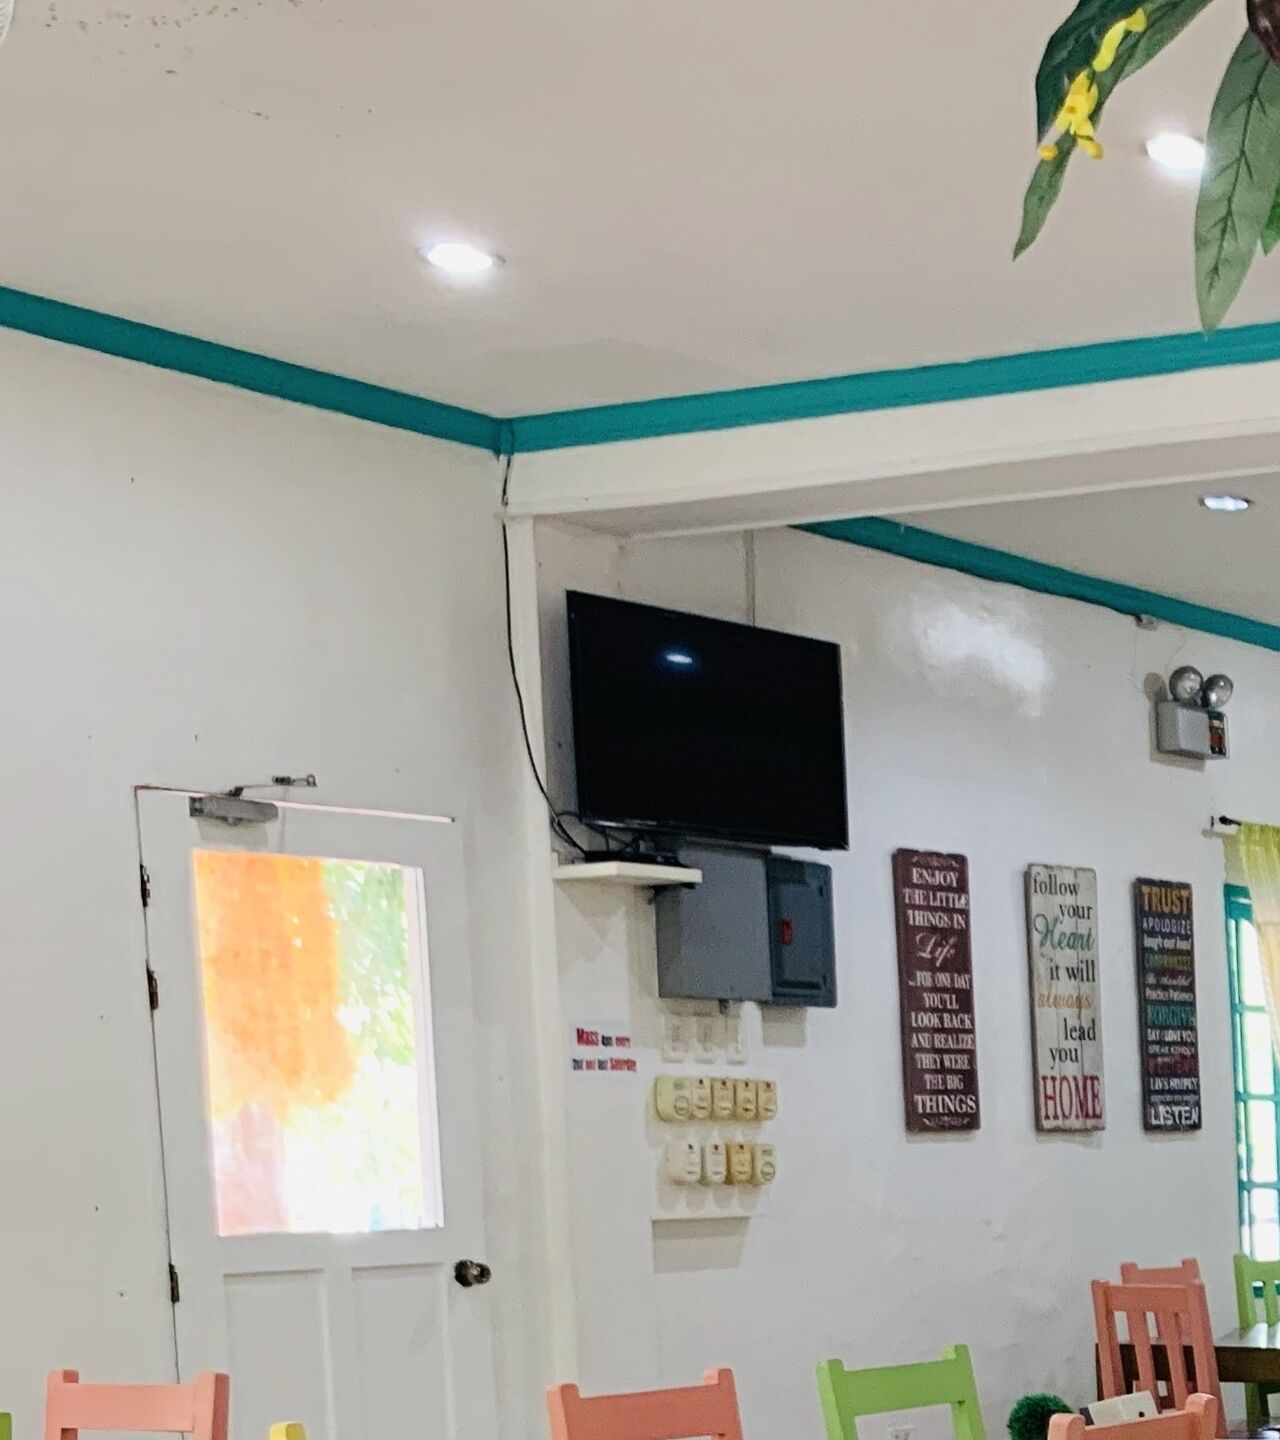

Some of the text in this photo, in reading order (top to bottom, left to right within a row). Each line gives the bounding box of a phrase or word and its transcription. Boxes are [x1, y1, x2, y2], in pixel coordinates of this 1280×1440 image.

[912, 867, 959, 888] ENJOY
[1033, 871, 1080, 896] follow
[903, 887, 970, 909] THE LITTLE
[1141, 884, 1191, 915] TRUST
[906, 909, 967, 930] THINGS IN
[1058, 903, 1094, 925] your
[1033, 913, 1096, 951] Heart
[1142, 917, 1192, 935] APOLOGIZE
[915, 932, 957, 967] Life
[1049, 957, 1096, 982] it will
[934, 972, 951, 988] ONE
[954, 973, 971, 990] DAY
[911, 1011, 973, 1030] LOOK BACK
[1063, 1017, 1096, 1041] lead
[576, 1028, 599, 1047] Mass
[911, 1032, 976, 1051] AND REALIZE
[915, 1053, 971, 1071] THEY WERE
[1049, 1047, 1079, 1070] you
[924, 1073, 964, 1091] THE BIG
[913, 1094, 977, 1114] THINGS
[1041, 1074, 1103, 1121] HOME
[1150, 1103, 1200, 1126] LISTEN
